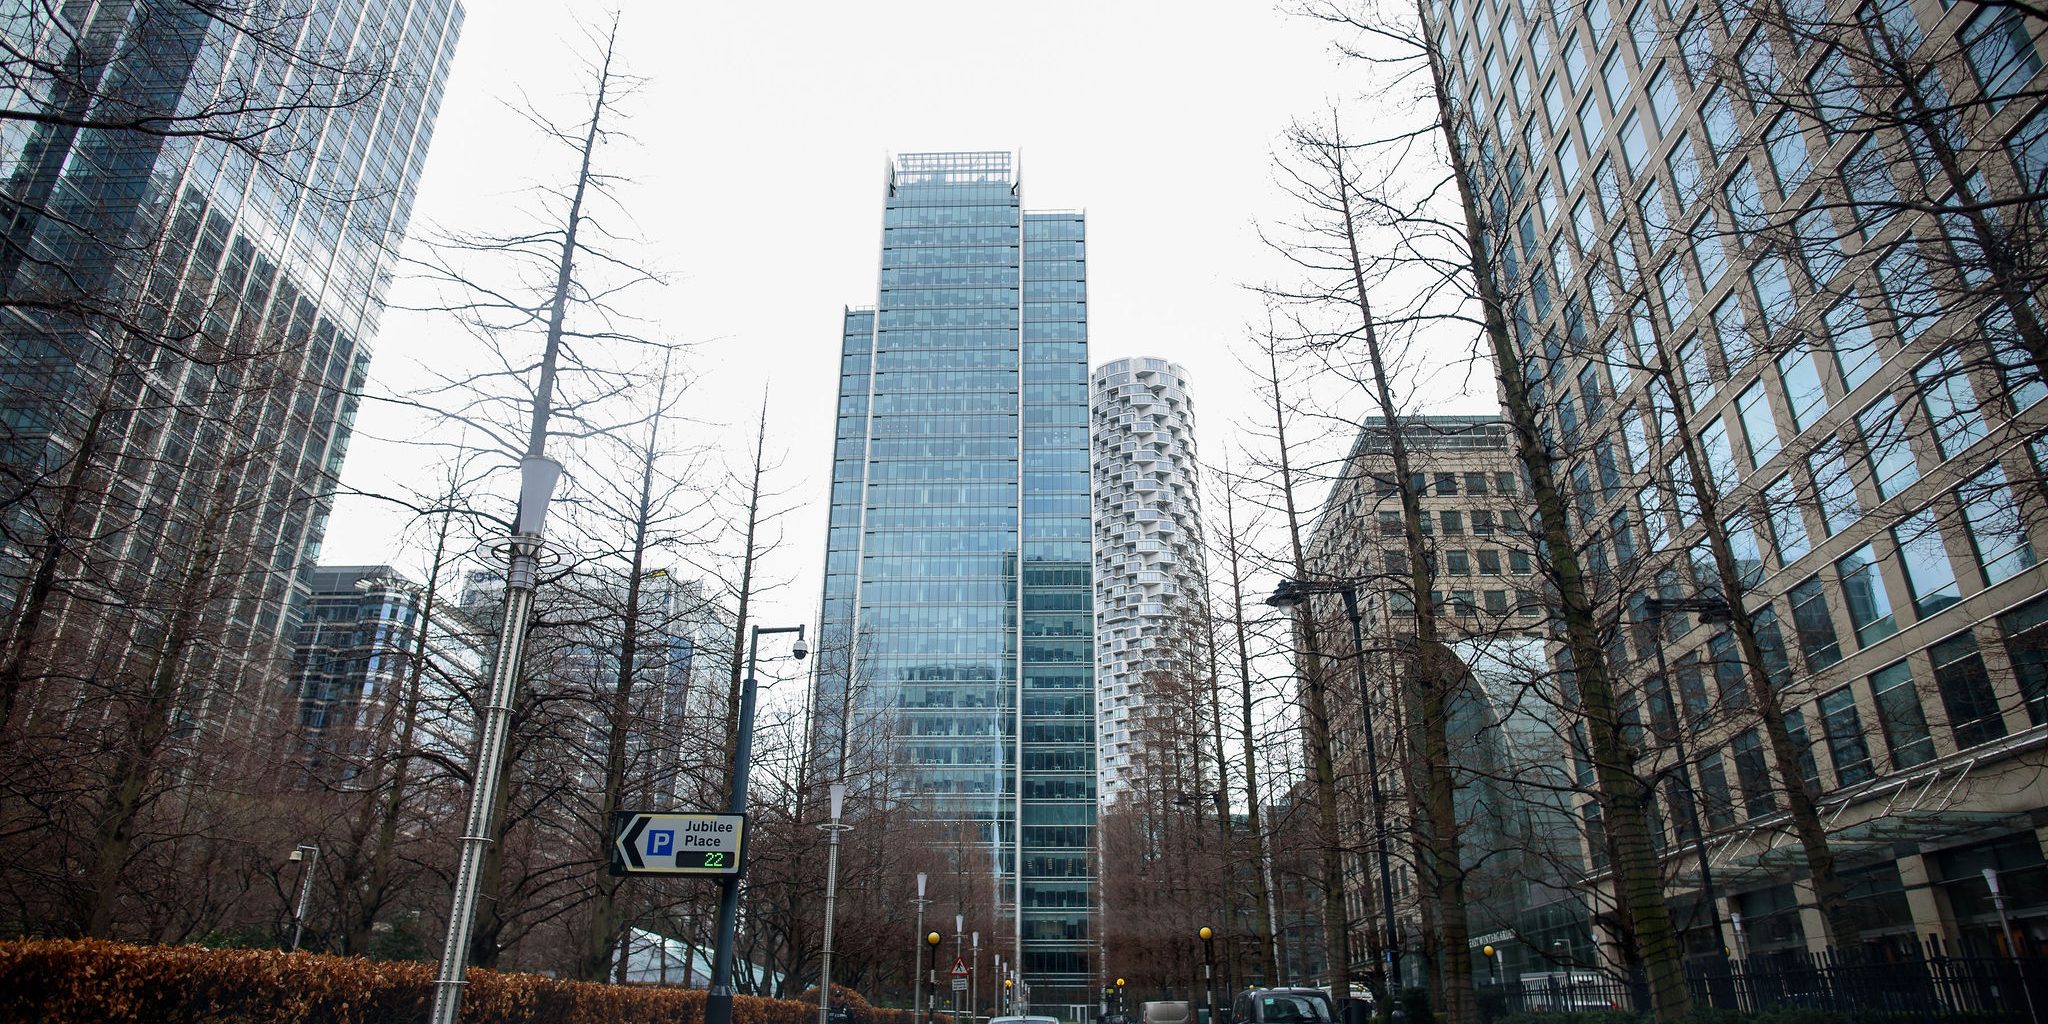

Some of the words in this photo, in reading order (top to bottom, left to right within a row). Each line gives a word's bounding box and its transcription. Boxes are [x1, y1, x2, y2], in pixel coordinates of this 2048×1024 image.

[685, 820, 733, 833] Jubilee
[653, 832, 670, 854] P
[684, 834, 721, 847] Place
[704, 852, 724, 867] 22
